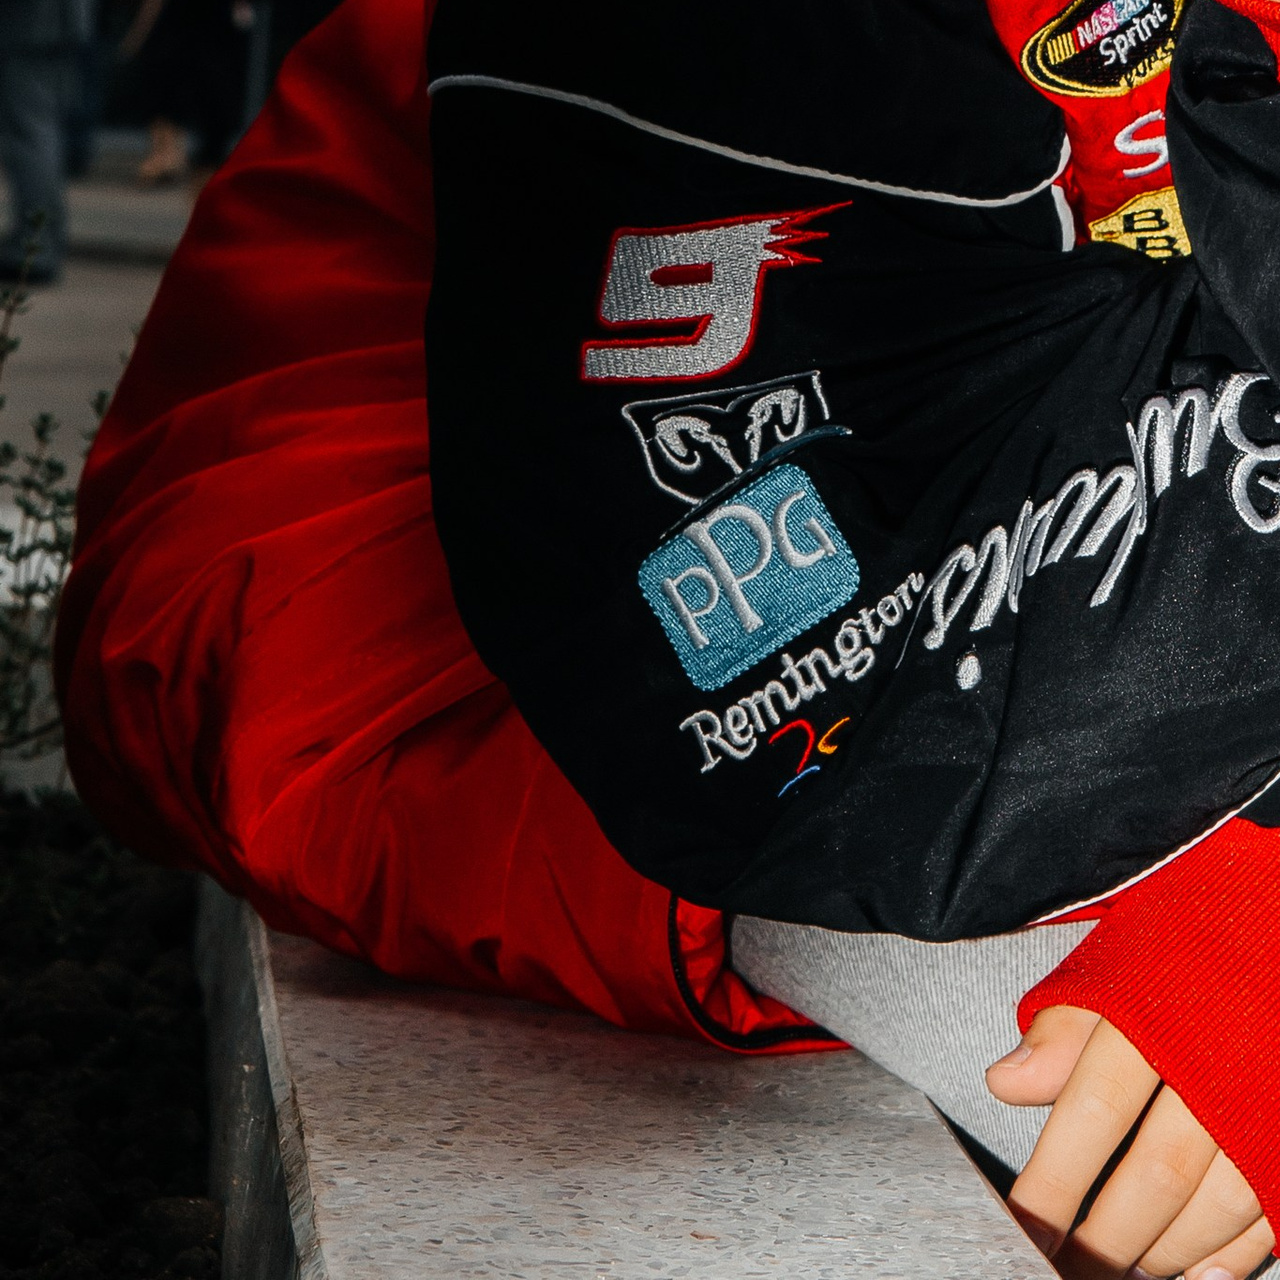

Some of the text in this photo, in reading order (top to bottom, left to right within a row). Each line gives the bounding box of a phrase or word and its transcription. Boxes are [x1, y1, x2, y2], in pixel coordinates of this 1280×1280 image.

[1099, 2, 1169, 67] Sprint
[581, 201, 853, 380] 9
[661, 489, 837, 652] PPG
[678, 571, 927, 773] Remington
